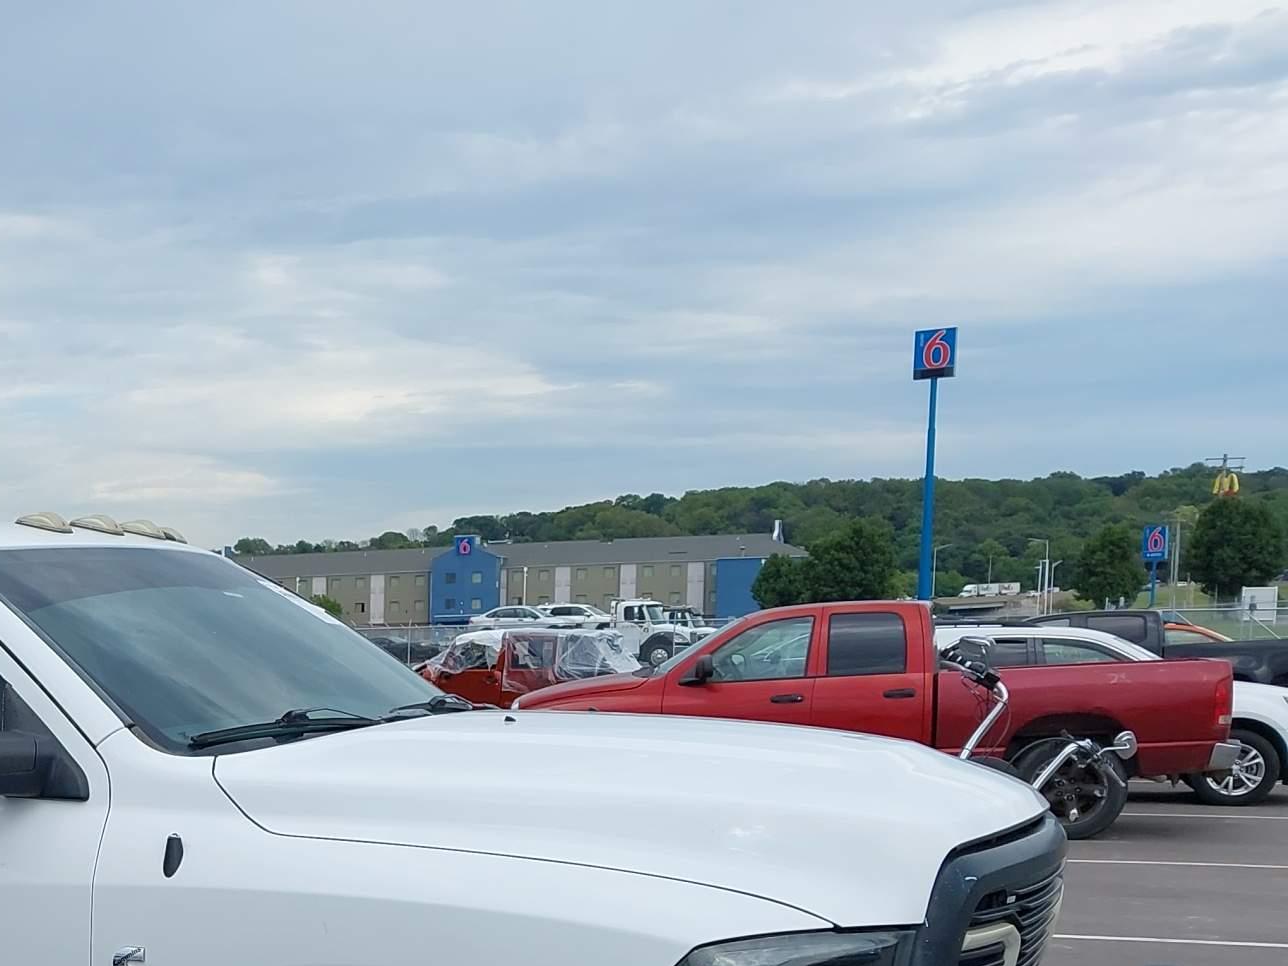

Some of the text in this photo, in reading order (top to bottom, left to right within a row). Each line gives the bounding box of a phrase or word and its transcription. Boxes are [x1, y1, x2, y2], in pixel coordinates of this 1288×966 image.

[923, 329, 950, 369] 6
[459, 538, 471, 554] 6
[1148, 526, 1164, 552] 6
